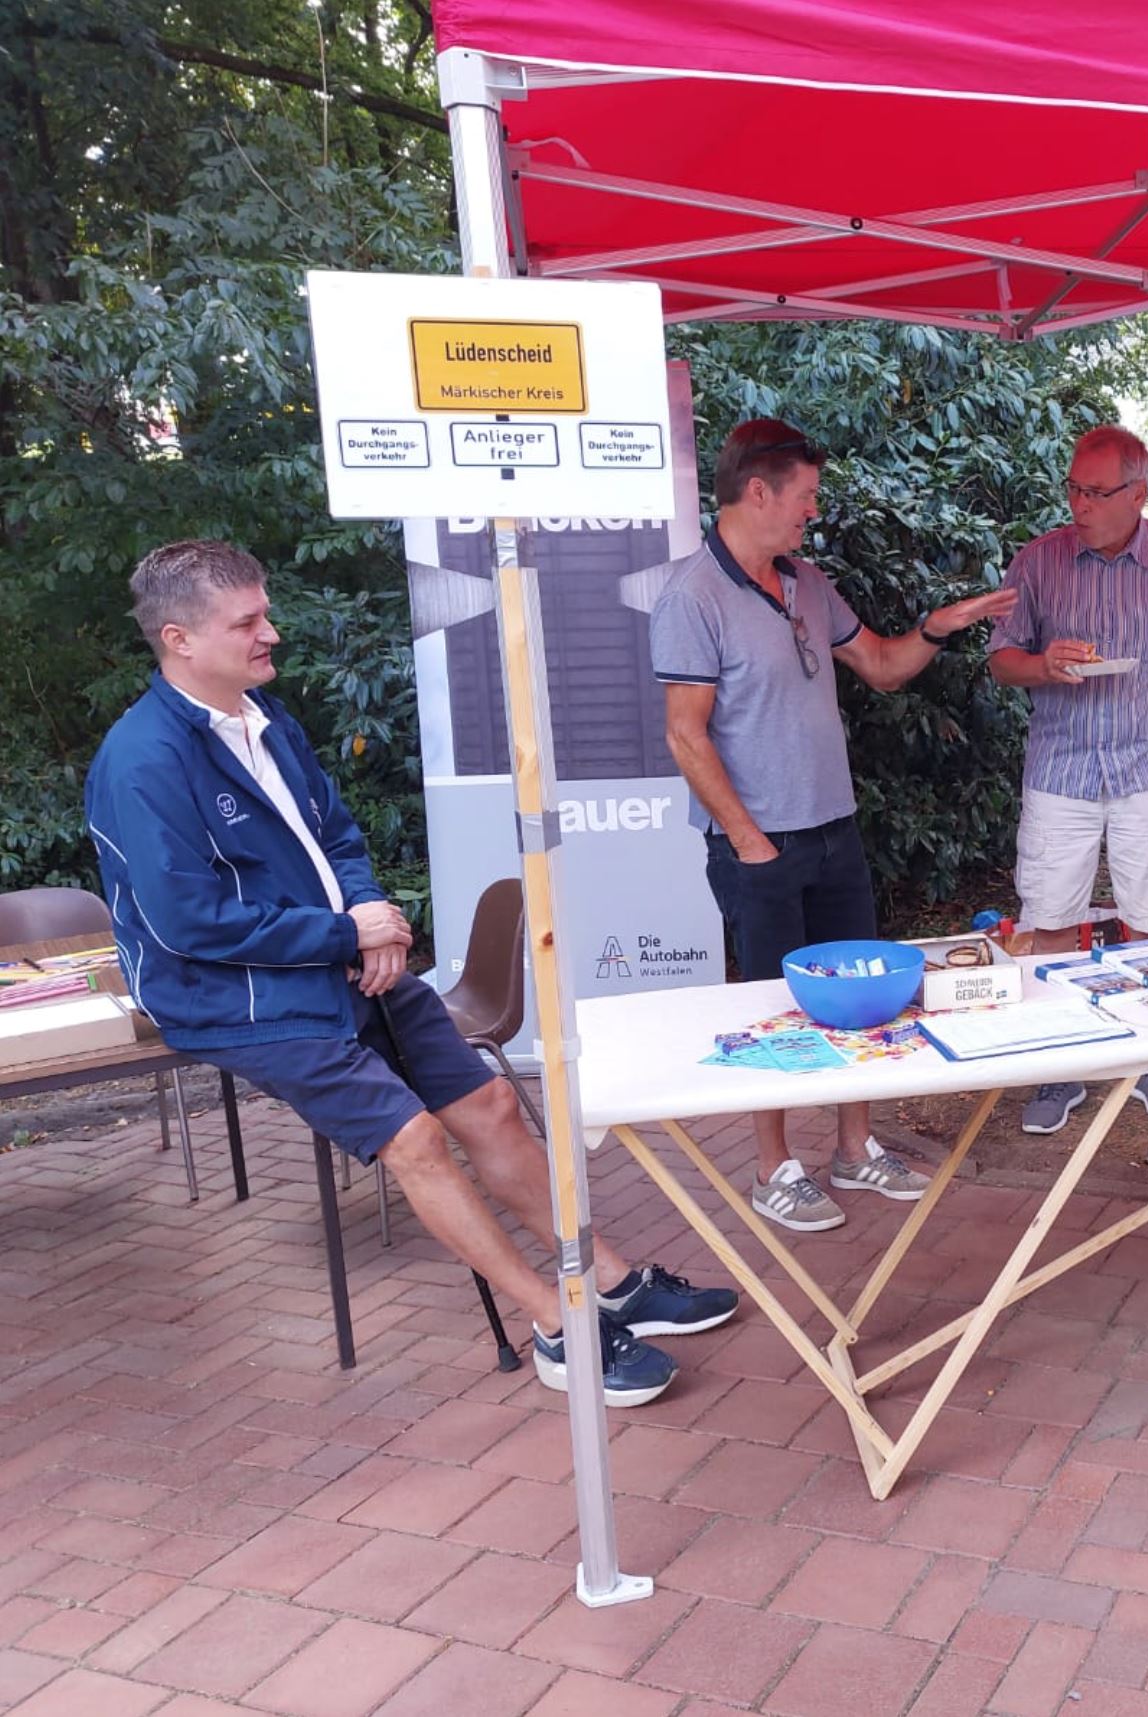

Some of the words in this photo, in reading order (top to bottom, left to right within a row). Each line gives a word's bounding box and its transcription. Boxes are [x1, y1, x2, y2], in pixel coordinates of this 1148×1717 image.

[445, 341, 553, 363] Lüdenscheid
[440, 384, 523, 399] Märkischer
[526, 386, 565, 400] Kreis
[371, 426, 398, 437] Kein
[610, 428, 635, 439] Kein
[463, 429, 546, 447] Anlieger
[347, 439, 420, 450] Durchgangs-
[588, 441, 656, 453] Durchgangs-
[363, 451, 408, 461] verkehr
[490, 446, 524, 460] frei
[602, 454, 643, 463] verkehr
[558, 796, 672, 833] auer
[638, 935, 661, 948] Die
[639, 948, 708, 963] Autobahn
[640, 966, 693, 977] Westfalen
